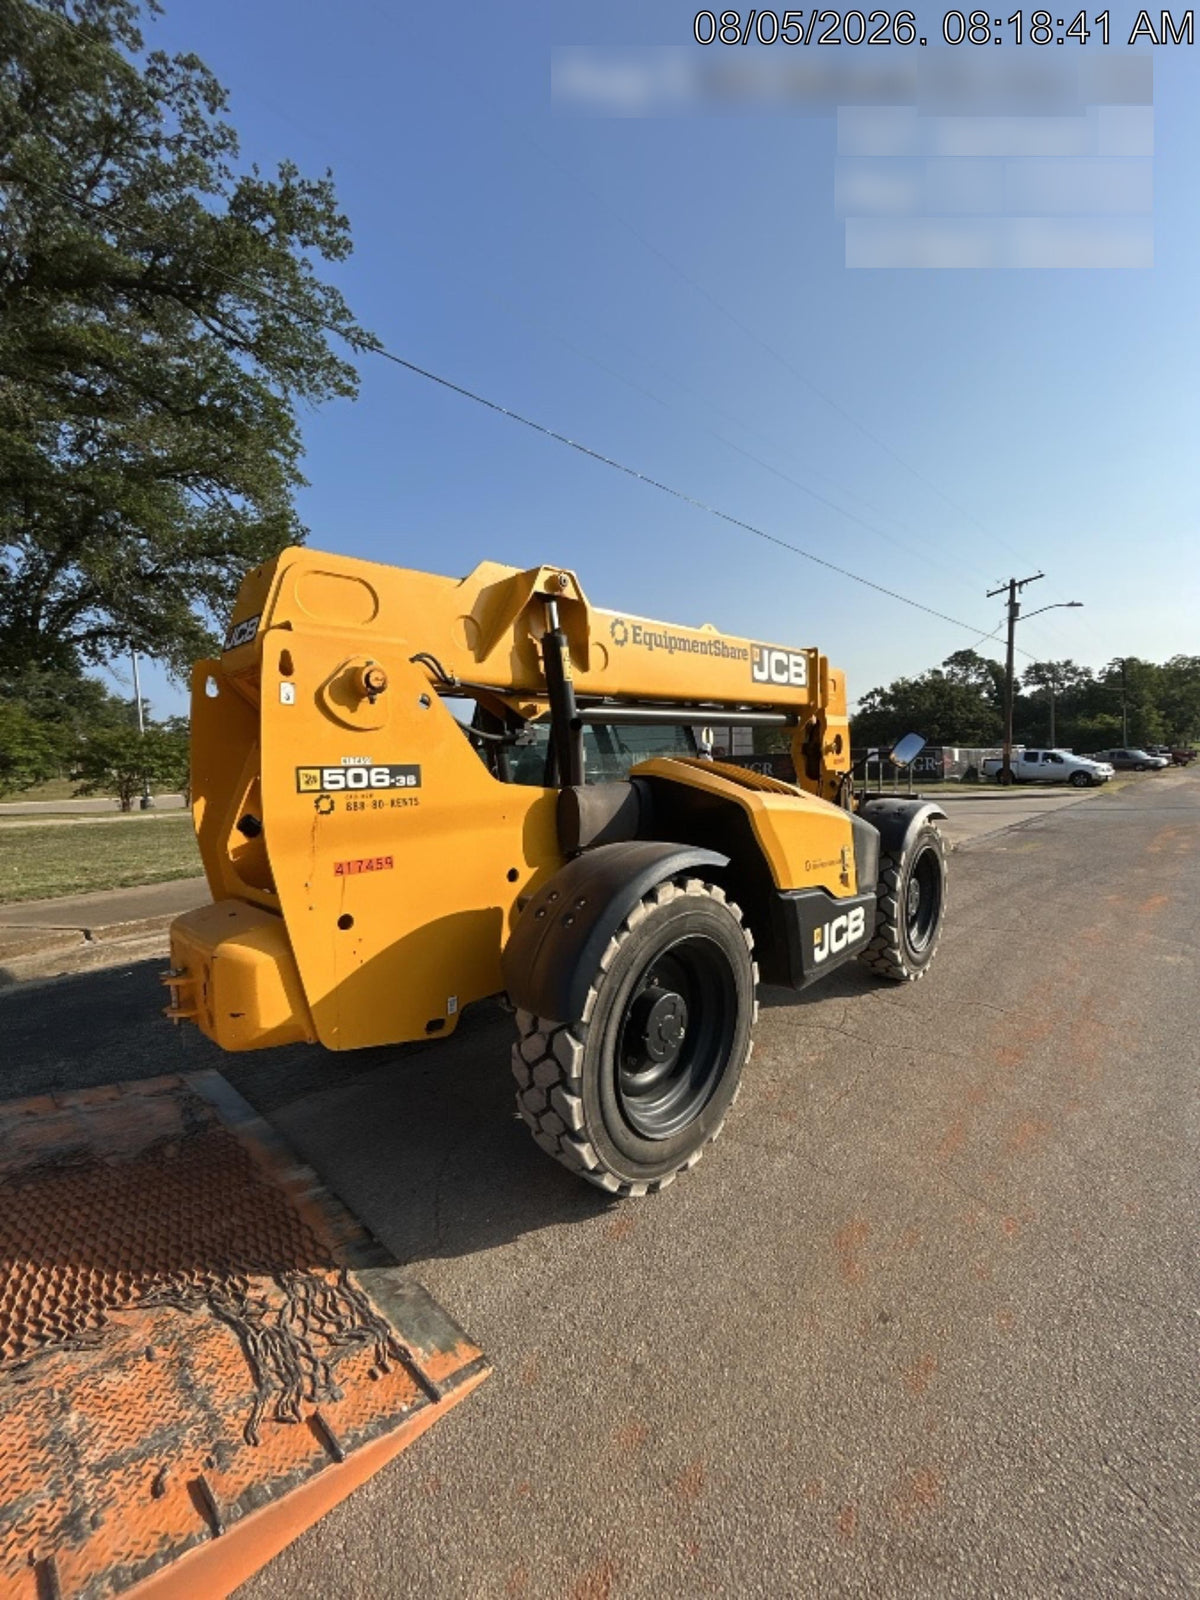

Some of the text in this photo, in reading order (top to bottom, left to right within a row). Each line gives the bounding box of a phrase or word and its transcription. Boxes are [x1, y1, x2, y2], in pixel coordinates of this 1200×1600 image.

[224, 616, 260, 650] JCB
[631, 624, 749, 661] EquipmentShare
[752, 647, 807, 686] JCB
[335, 856, 394, 876] 417459
[814, 906, 865, 963] JCB
